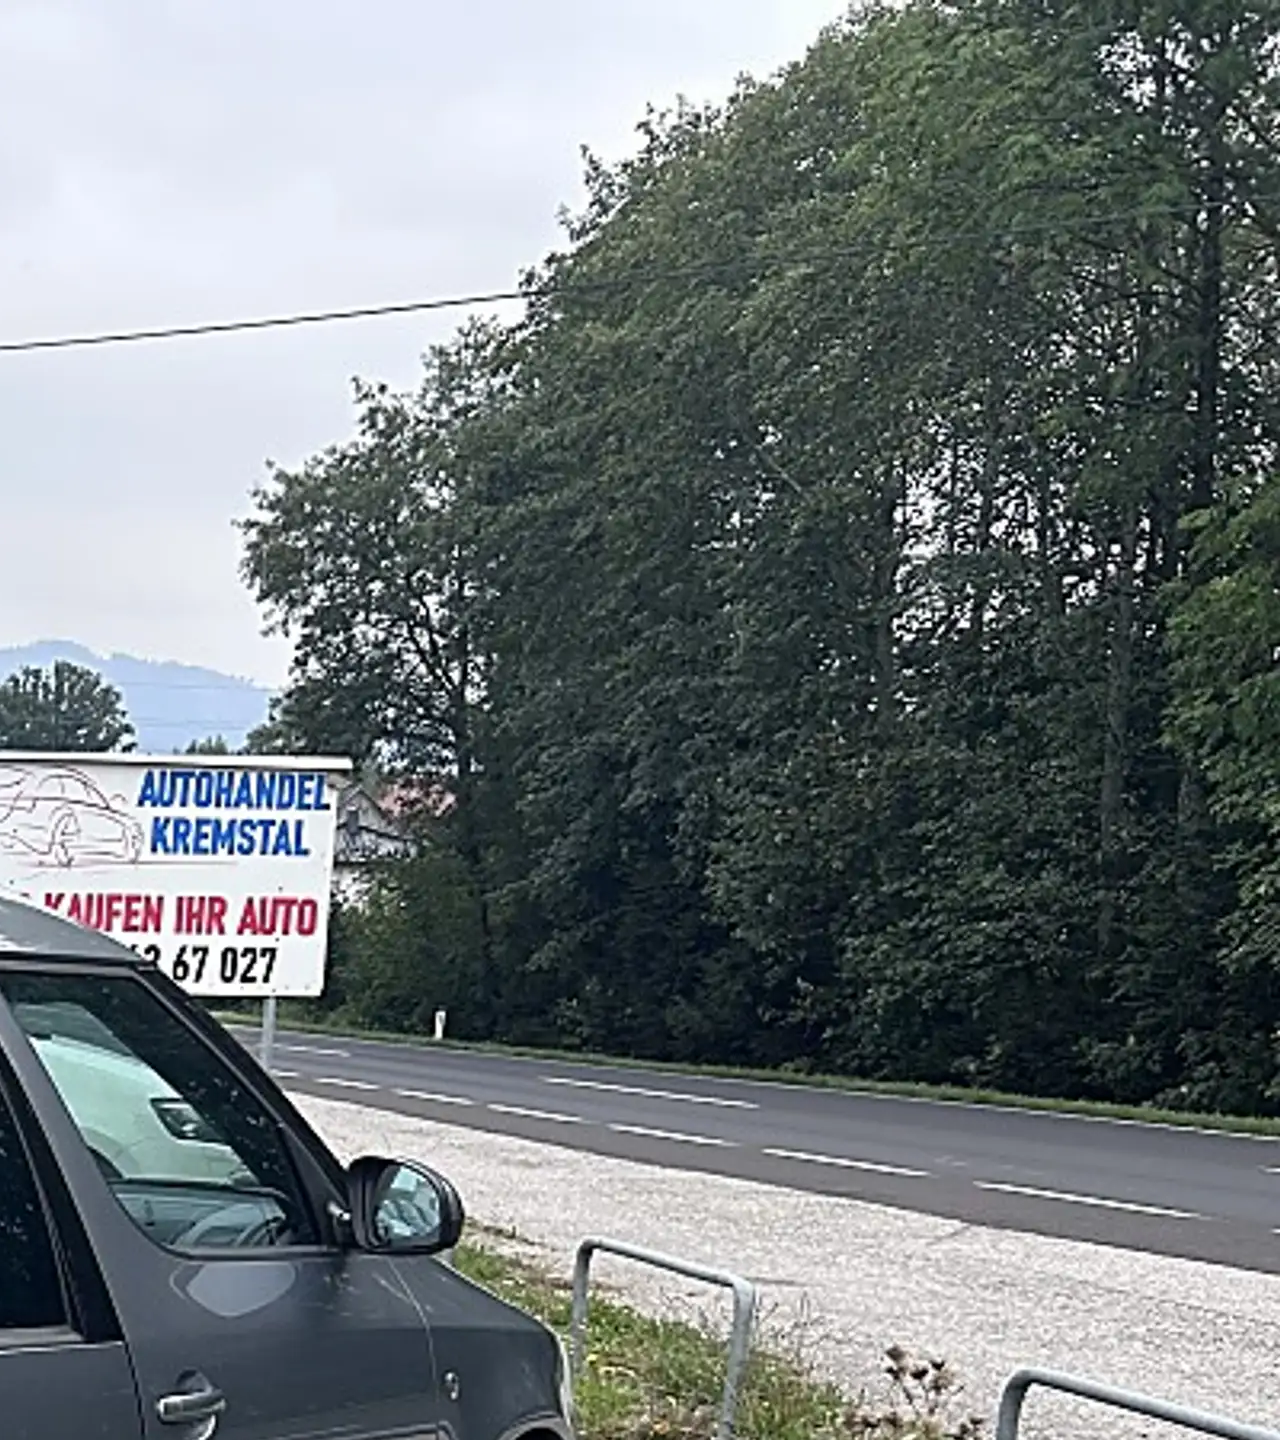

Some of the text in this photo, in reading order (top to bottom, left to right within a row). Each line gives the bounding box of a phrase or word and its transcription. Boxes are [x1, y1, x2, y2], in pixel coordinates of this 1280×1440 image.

[138, 770, 331, 810] AUTOHANDEL
[151, 817, 310, 856] KREMSTAL
[174, 896, 227, 935] IHR
[237, 898, 317, 936] AUTO
[173, 945, 208, 983] 67
[220, 947, 279, 984] 027
